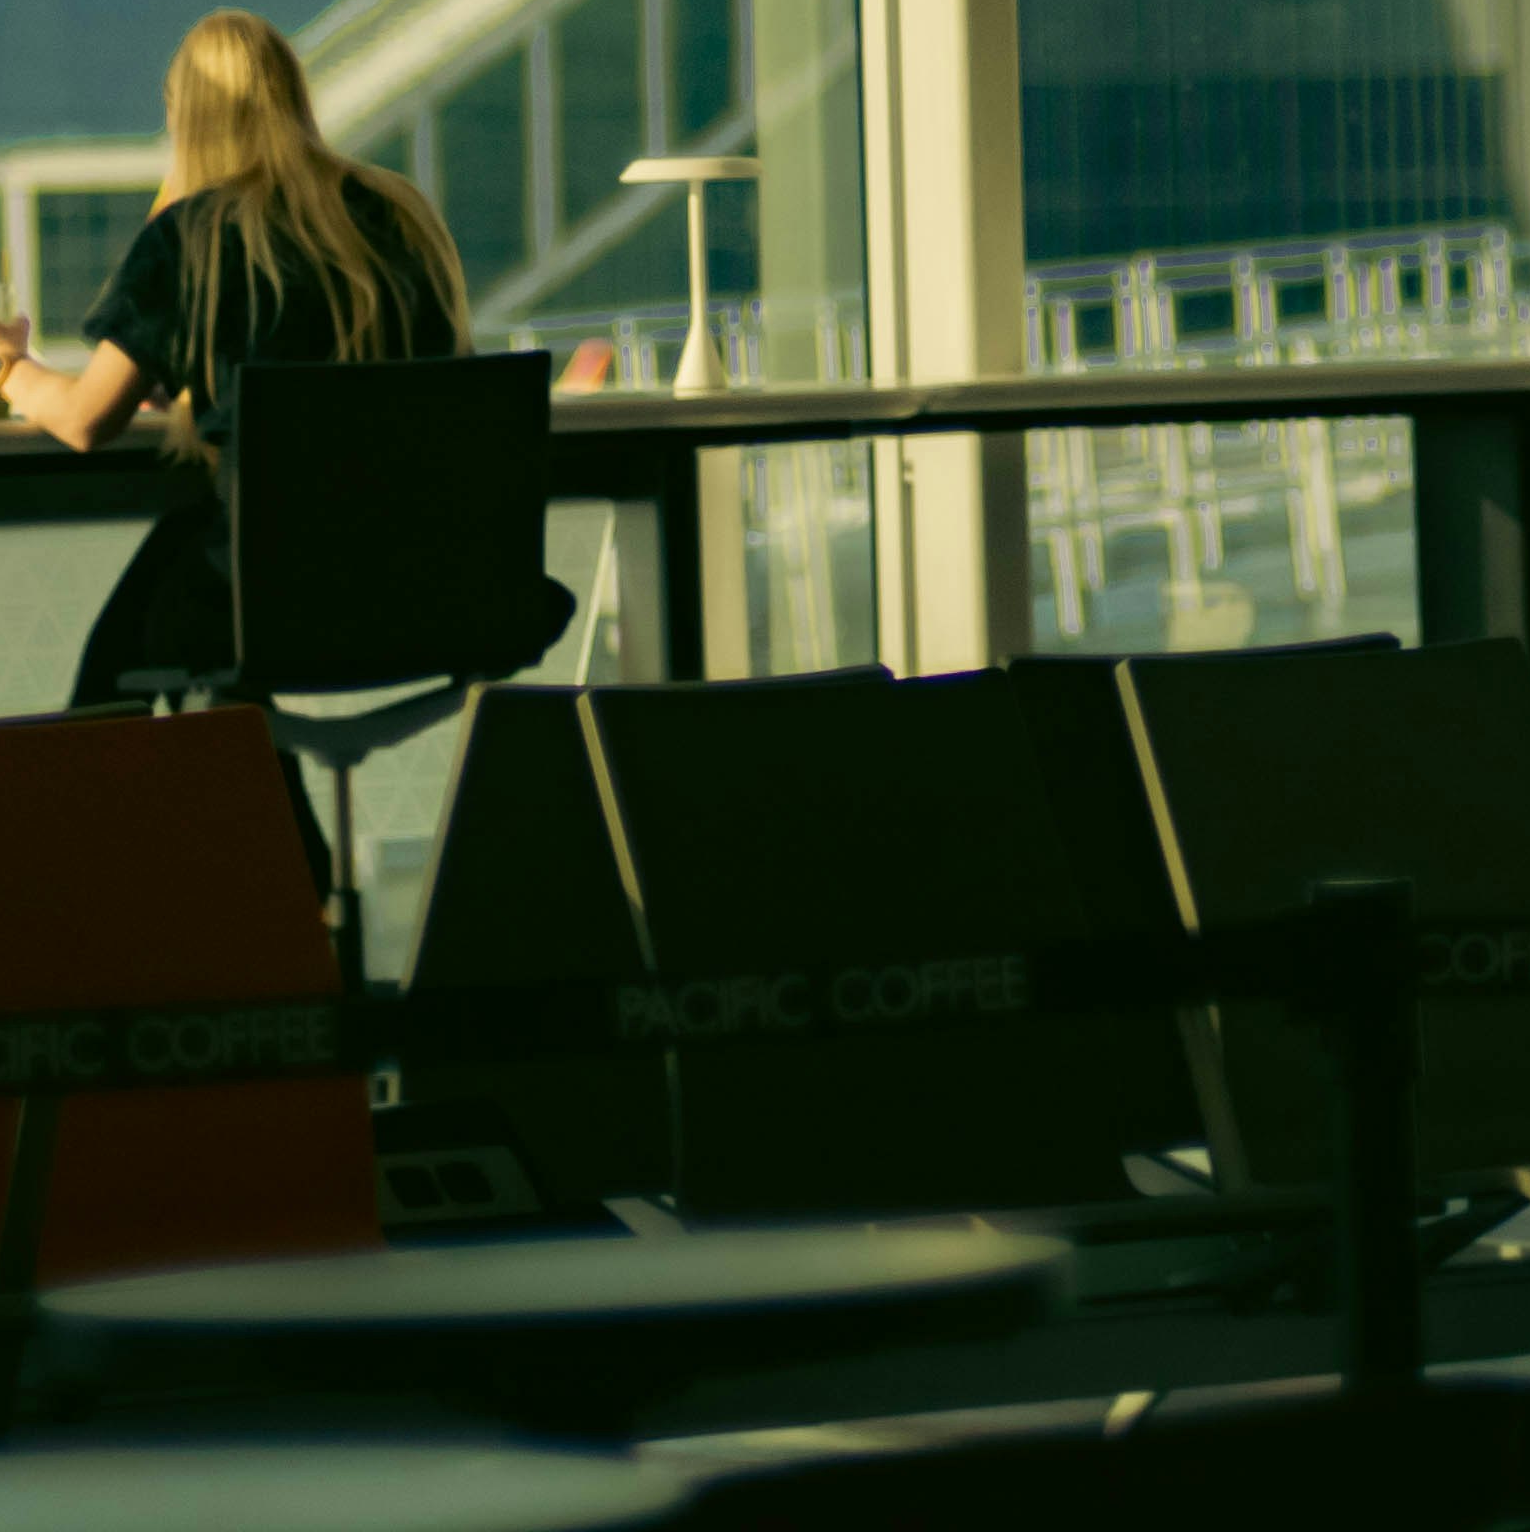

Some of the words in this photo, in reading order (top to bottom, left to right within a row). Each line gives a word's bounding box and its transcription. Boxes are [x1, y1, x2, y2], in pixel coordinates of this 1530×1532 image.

[616, 971, 812, 1039] PACIFIC
[831, 952, 1028, 1020] COFFEE
[127, 1004, 336, 1073] COFFEE
